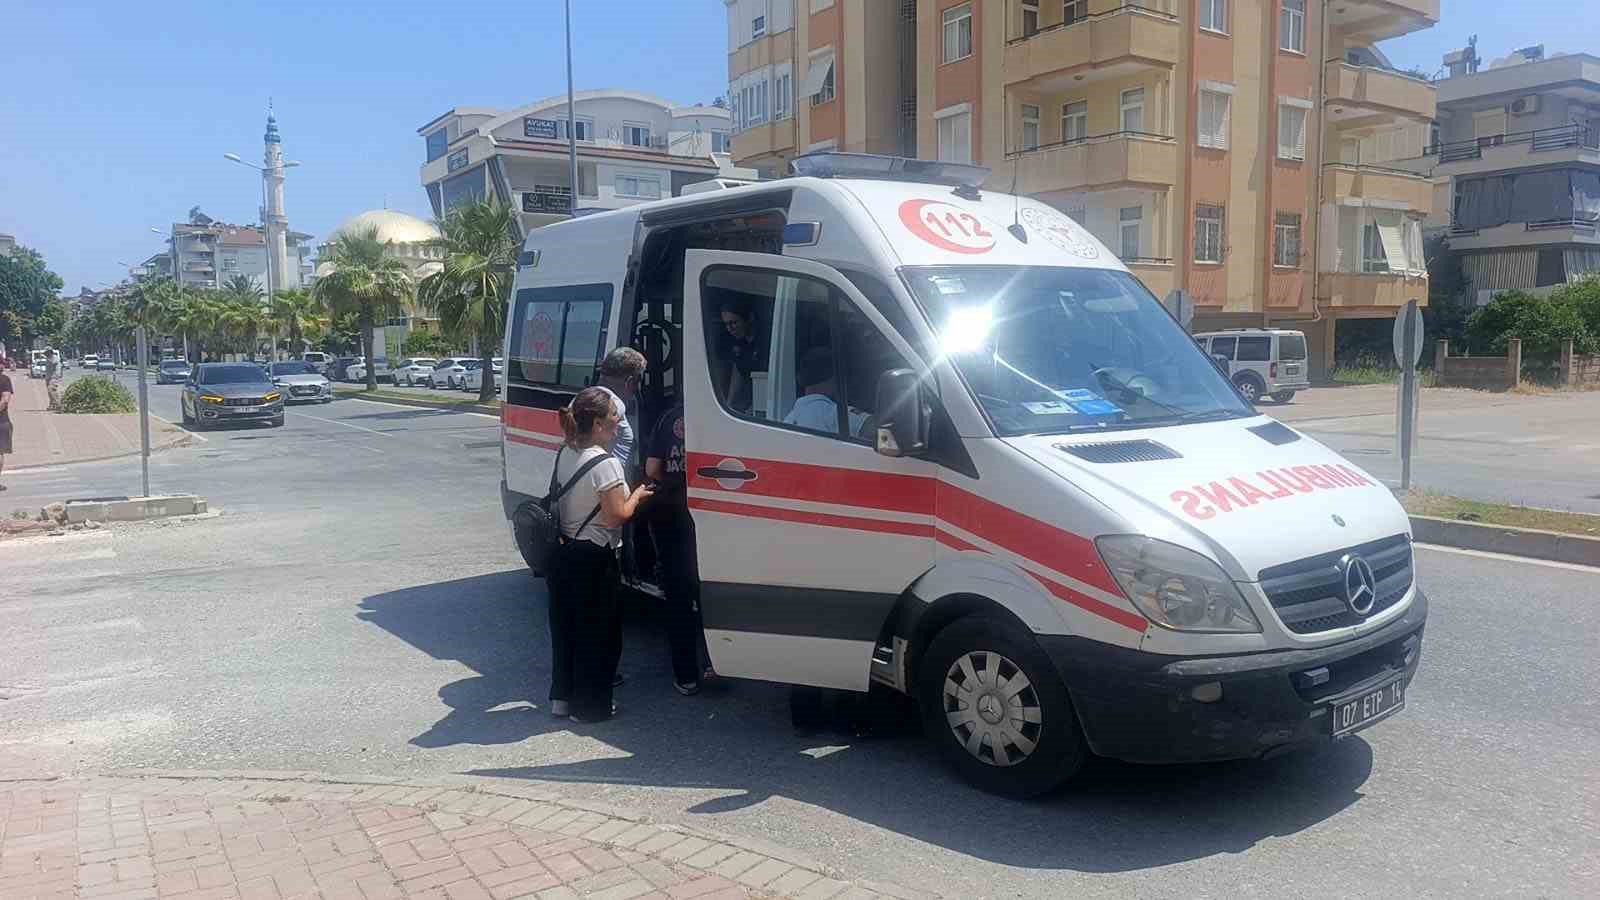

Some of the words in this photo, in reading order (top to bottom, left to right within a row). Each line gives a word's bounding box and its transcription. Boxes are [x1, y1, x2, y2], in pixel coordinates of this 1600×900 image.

[926, 211, 993, 237] 112
[1342, 701, 1358, 728] 07
[1363, 690, 1383, 719] ETP
